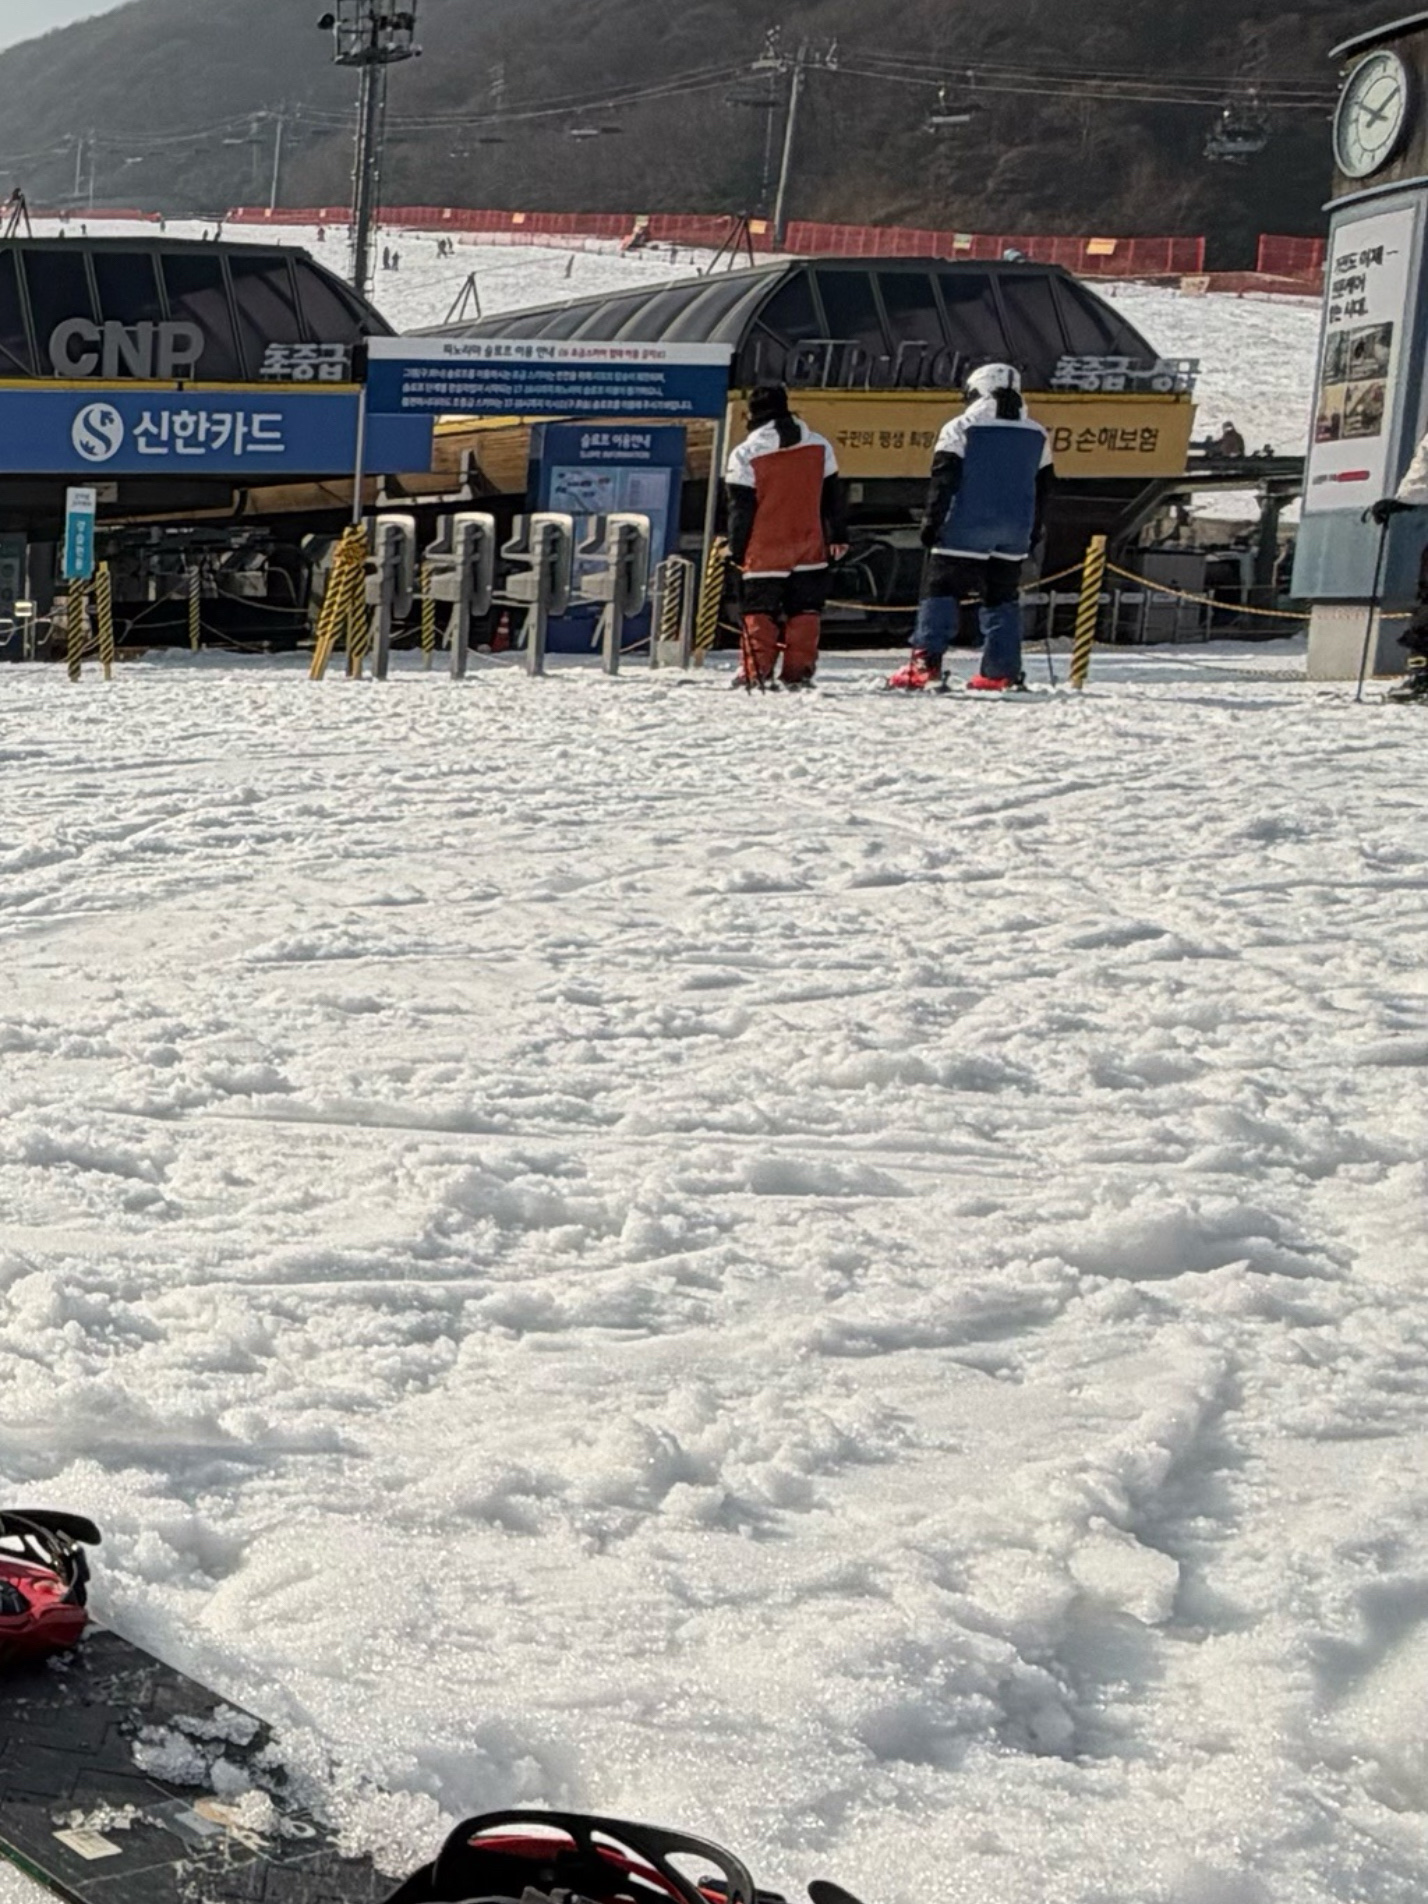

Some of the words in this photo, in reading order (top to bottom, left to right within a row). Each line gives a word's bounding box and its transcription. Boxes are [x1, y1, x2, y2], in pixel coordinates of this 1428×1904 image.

[49, 318, 205, 378] CNP
[259, 343, 348, 381] 초중급
[131, 409, 286, 455] 신한카드
[580, 433, 610, 449] 슬로프
[879, 430, 905, 448] 평생
[1048, 426, 1160, 453] B손해보험
